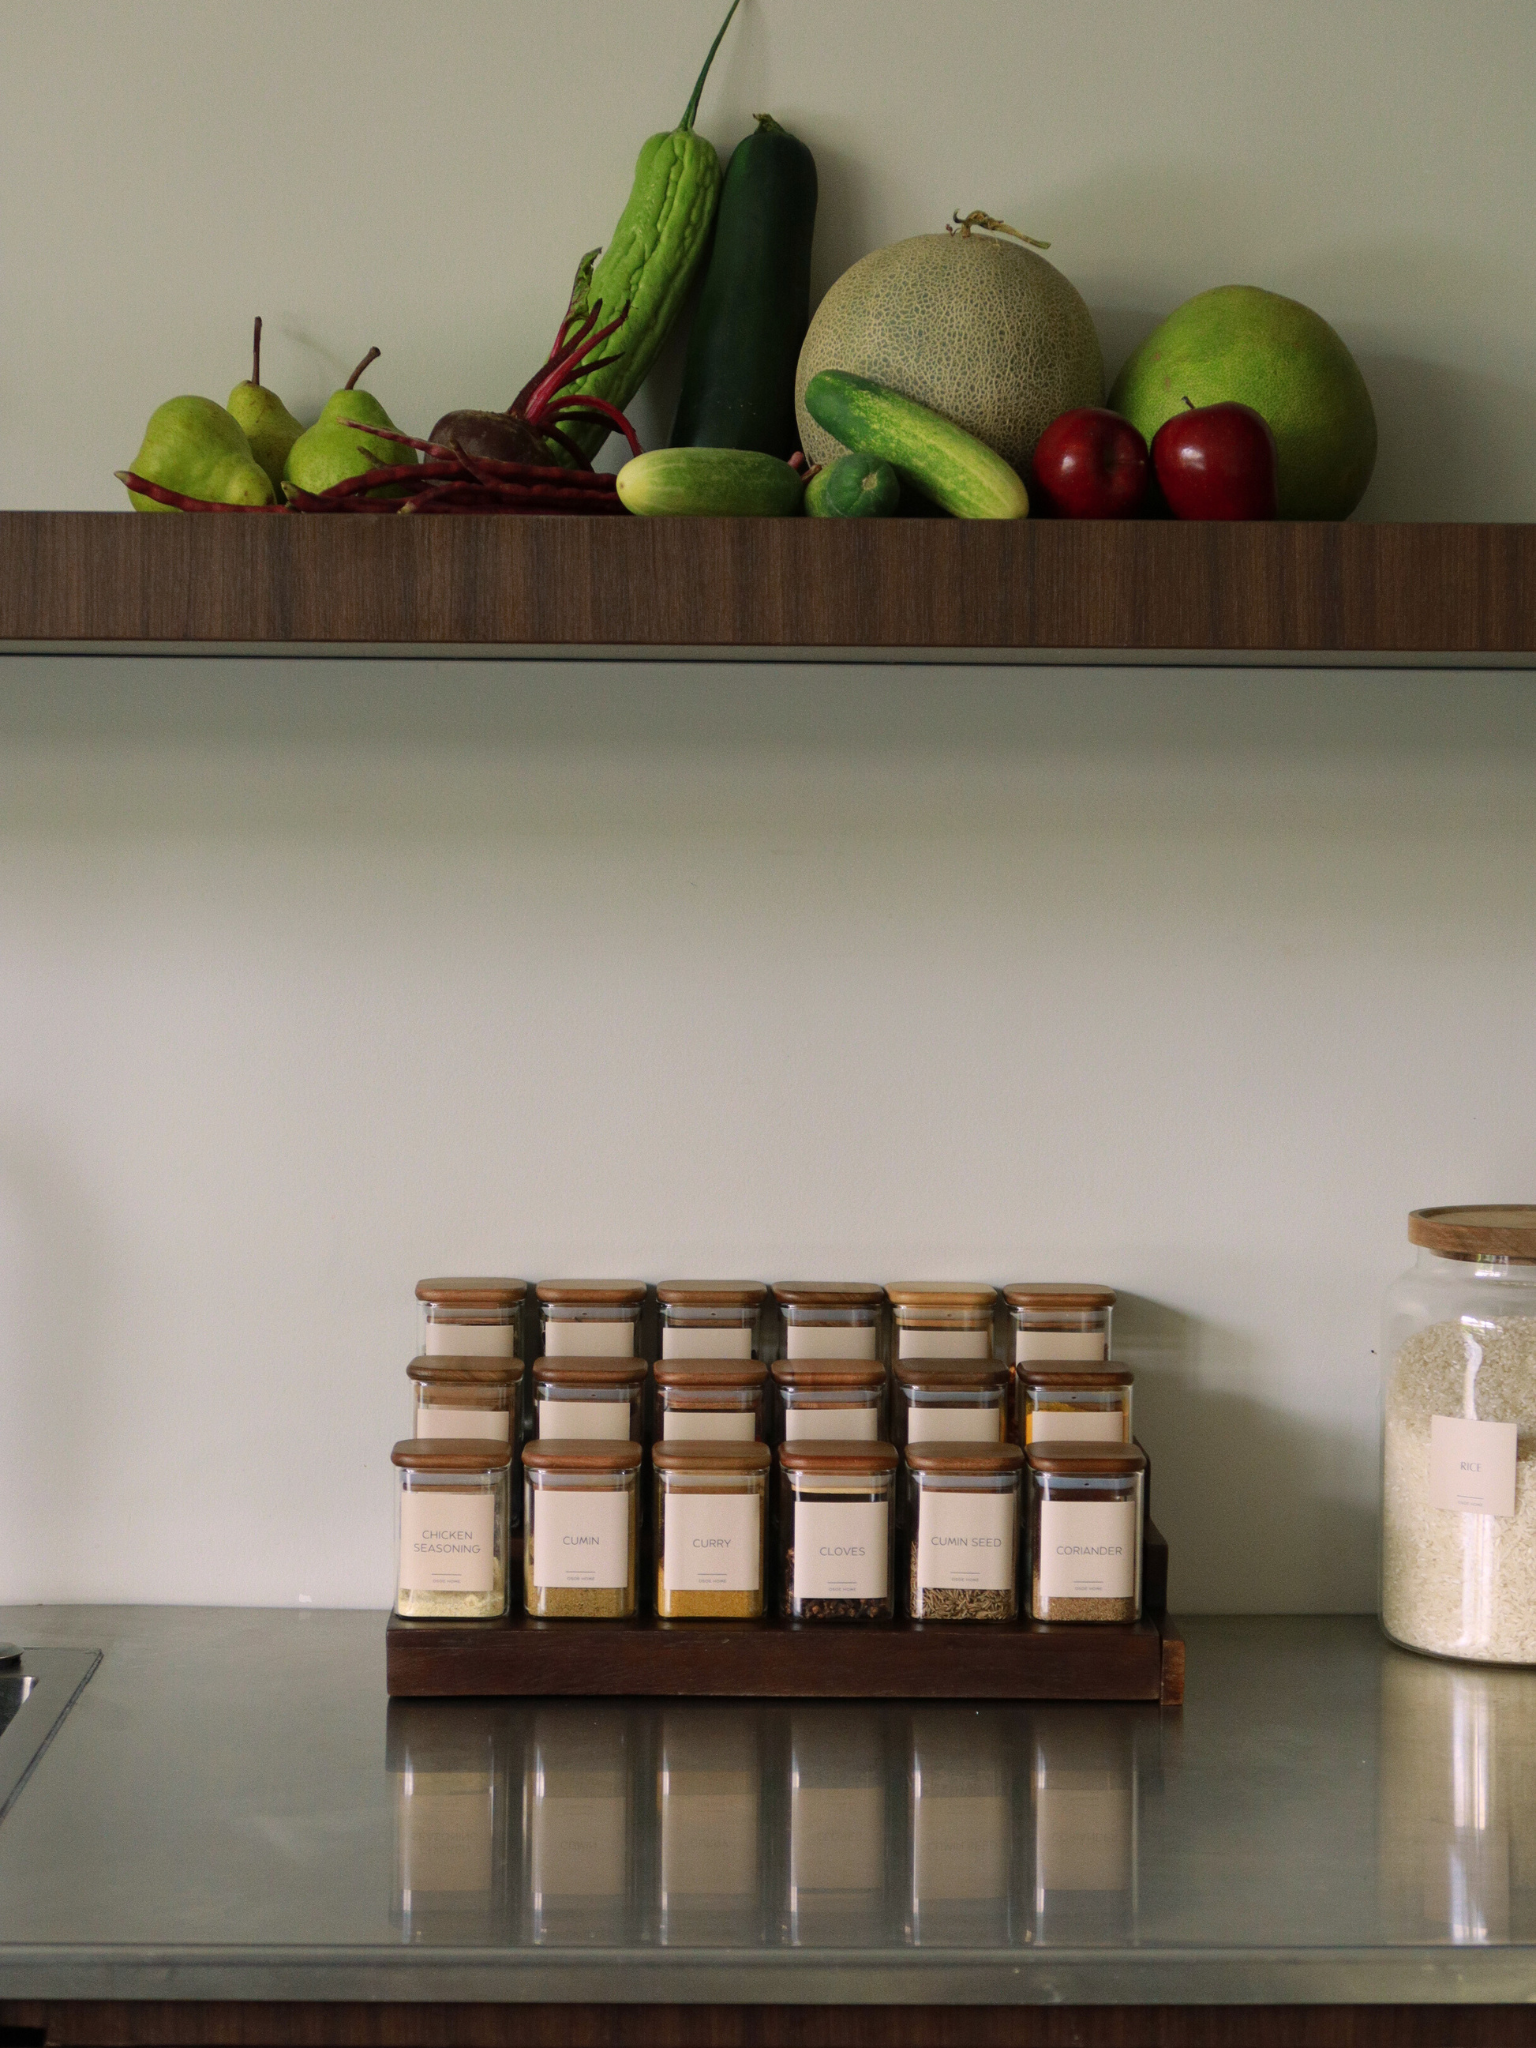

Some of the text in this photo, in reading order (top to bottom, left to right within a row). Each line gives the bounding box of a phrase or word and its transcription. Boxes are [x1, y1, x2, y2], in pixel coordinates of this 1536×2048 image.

[1460, 1461, 1482, 1472] RICE
[422, 1530, 472, 1541] CHICKEN
[562, 1536, 600, 1546] CUMIN
[693, 1539, 731, 1548] CURRY
[931, 1536, 1002, 1548] CUMIN SEED
[414, 1543, 482, 1554] SEASONING
[820, 1547, 866, 1556] CLOVES
[1056, 1546, 1122, 1556] CORIANDER
